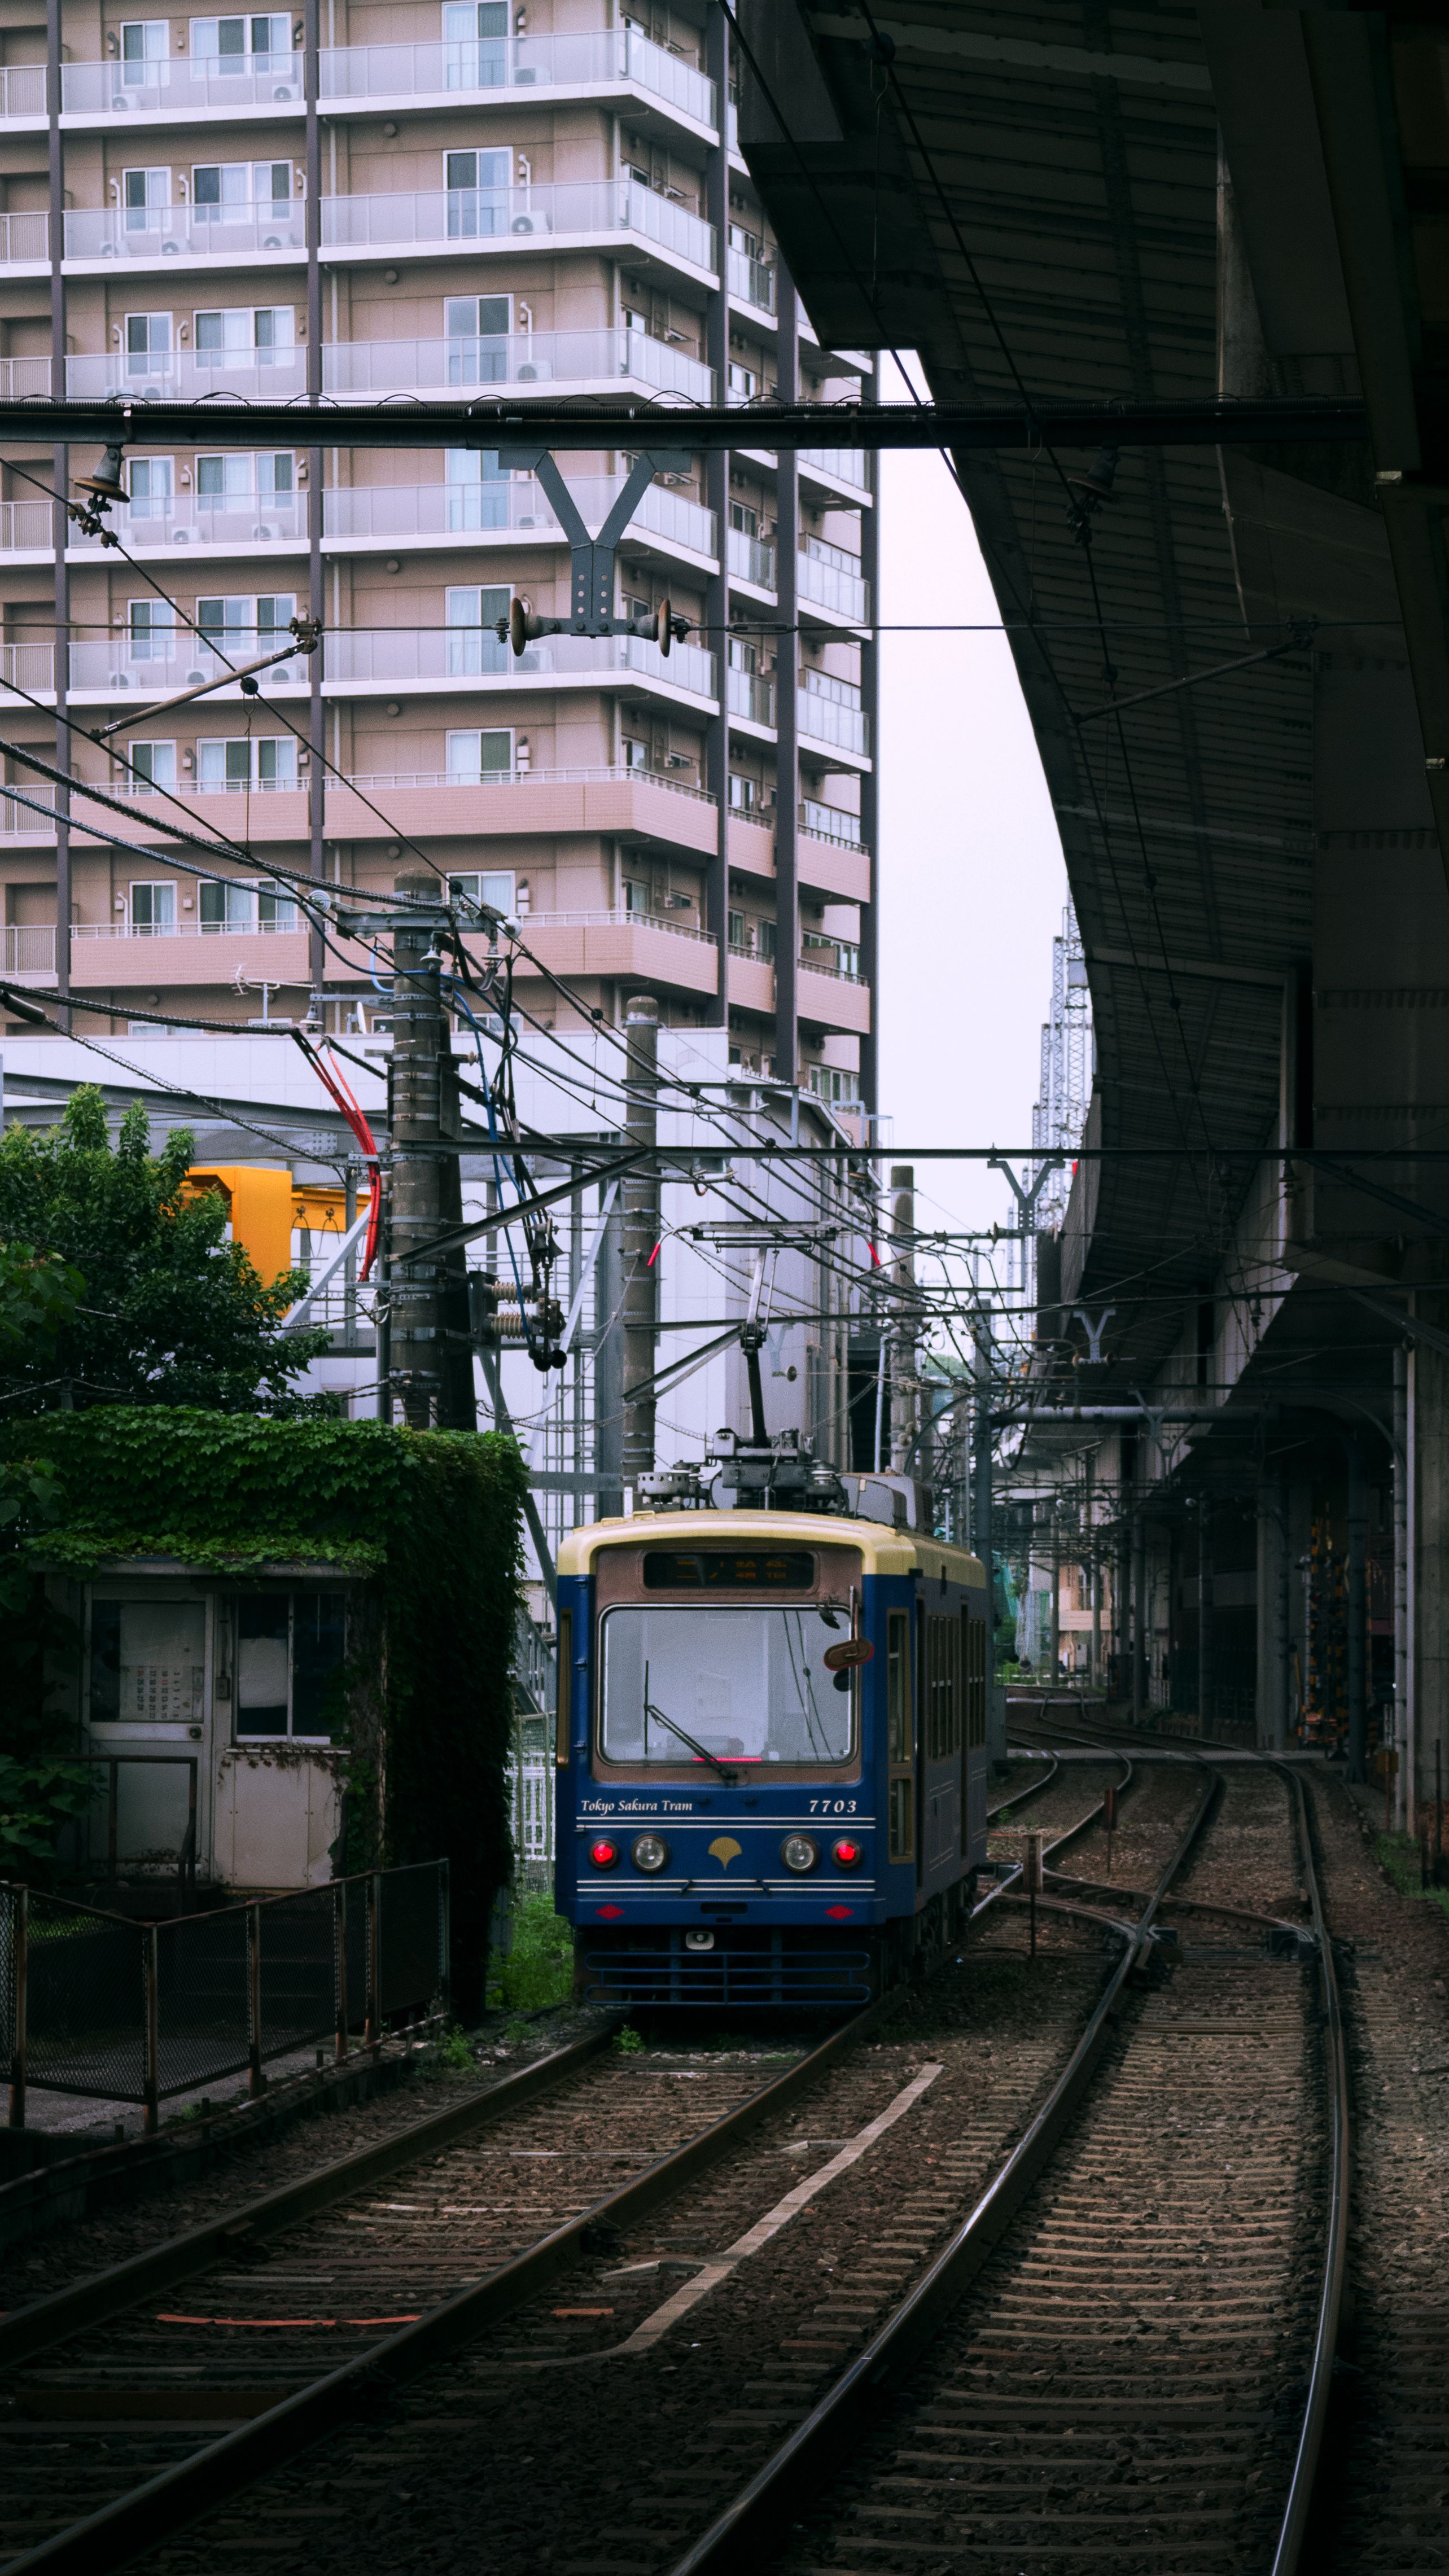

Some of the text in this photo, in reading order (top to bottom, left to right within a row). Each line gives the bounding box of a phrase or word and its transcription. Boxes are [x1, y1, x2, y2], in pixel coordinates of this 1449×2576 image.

[581, 1798, 693, 1816] Tokyo Sakura Tram
[809, 1799, 857, 1813] 7703
